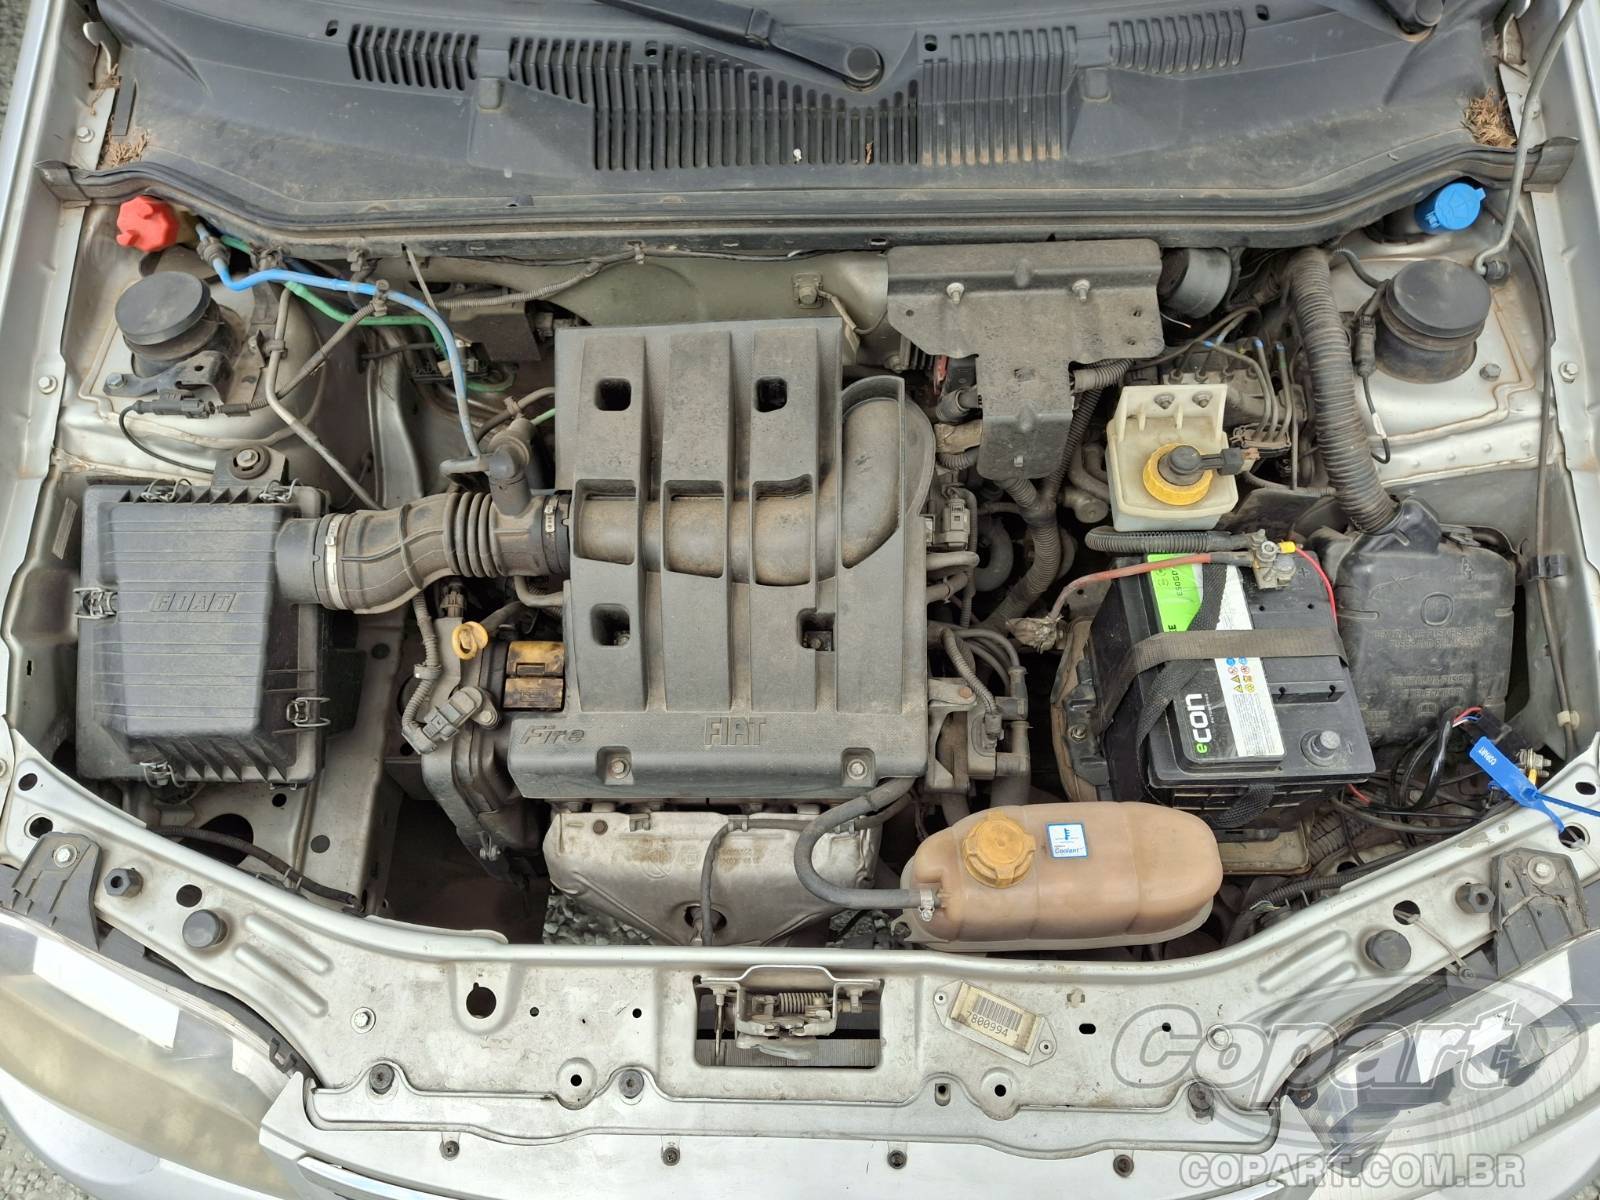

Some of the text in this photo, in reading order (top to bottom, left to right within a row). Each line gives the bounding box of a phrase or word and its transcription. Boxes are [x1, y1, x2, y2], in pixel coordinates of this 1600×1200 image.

[151, 592, 238, 612] FIAT
[521, 725, 585, 745] Fire
[704, 716, 767, 746] FIAT
[1184, 693, 1213, 754] econ
[966, 1010, 1009, 1038] 7800994
